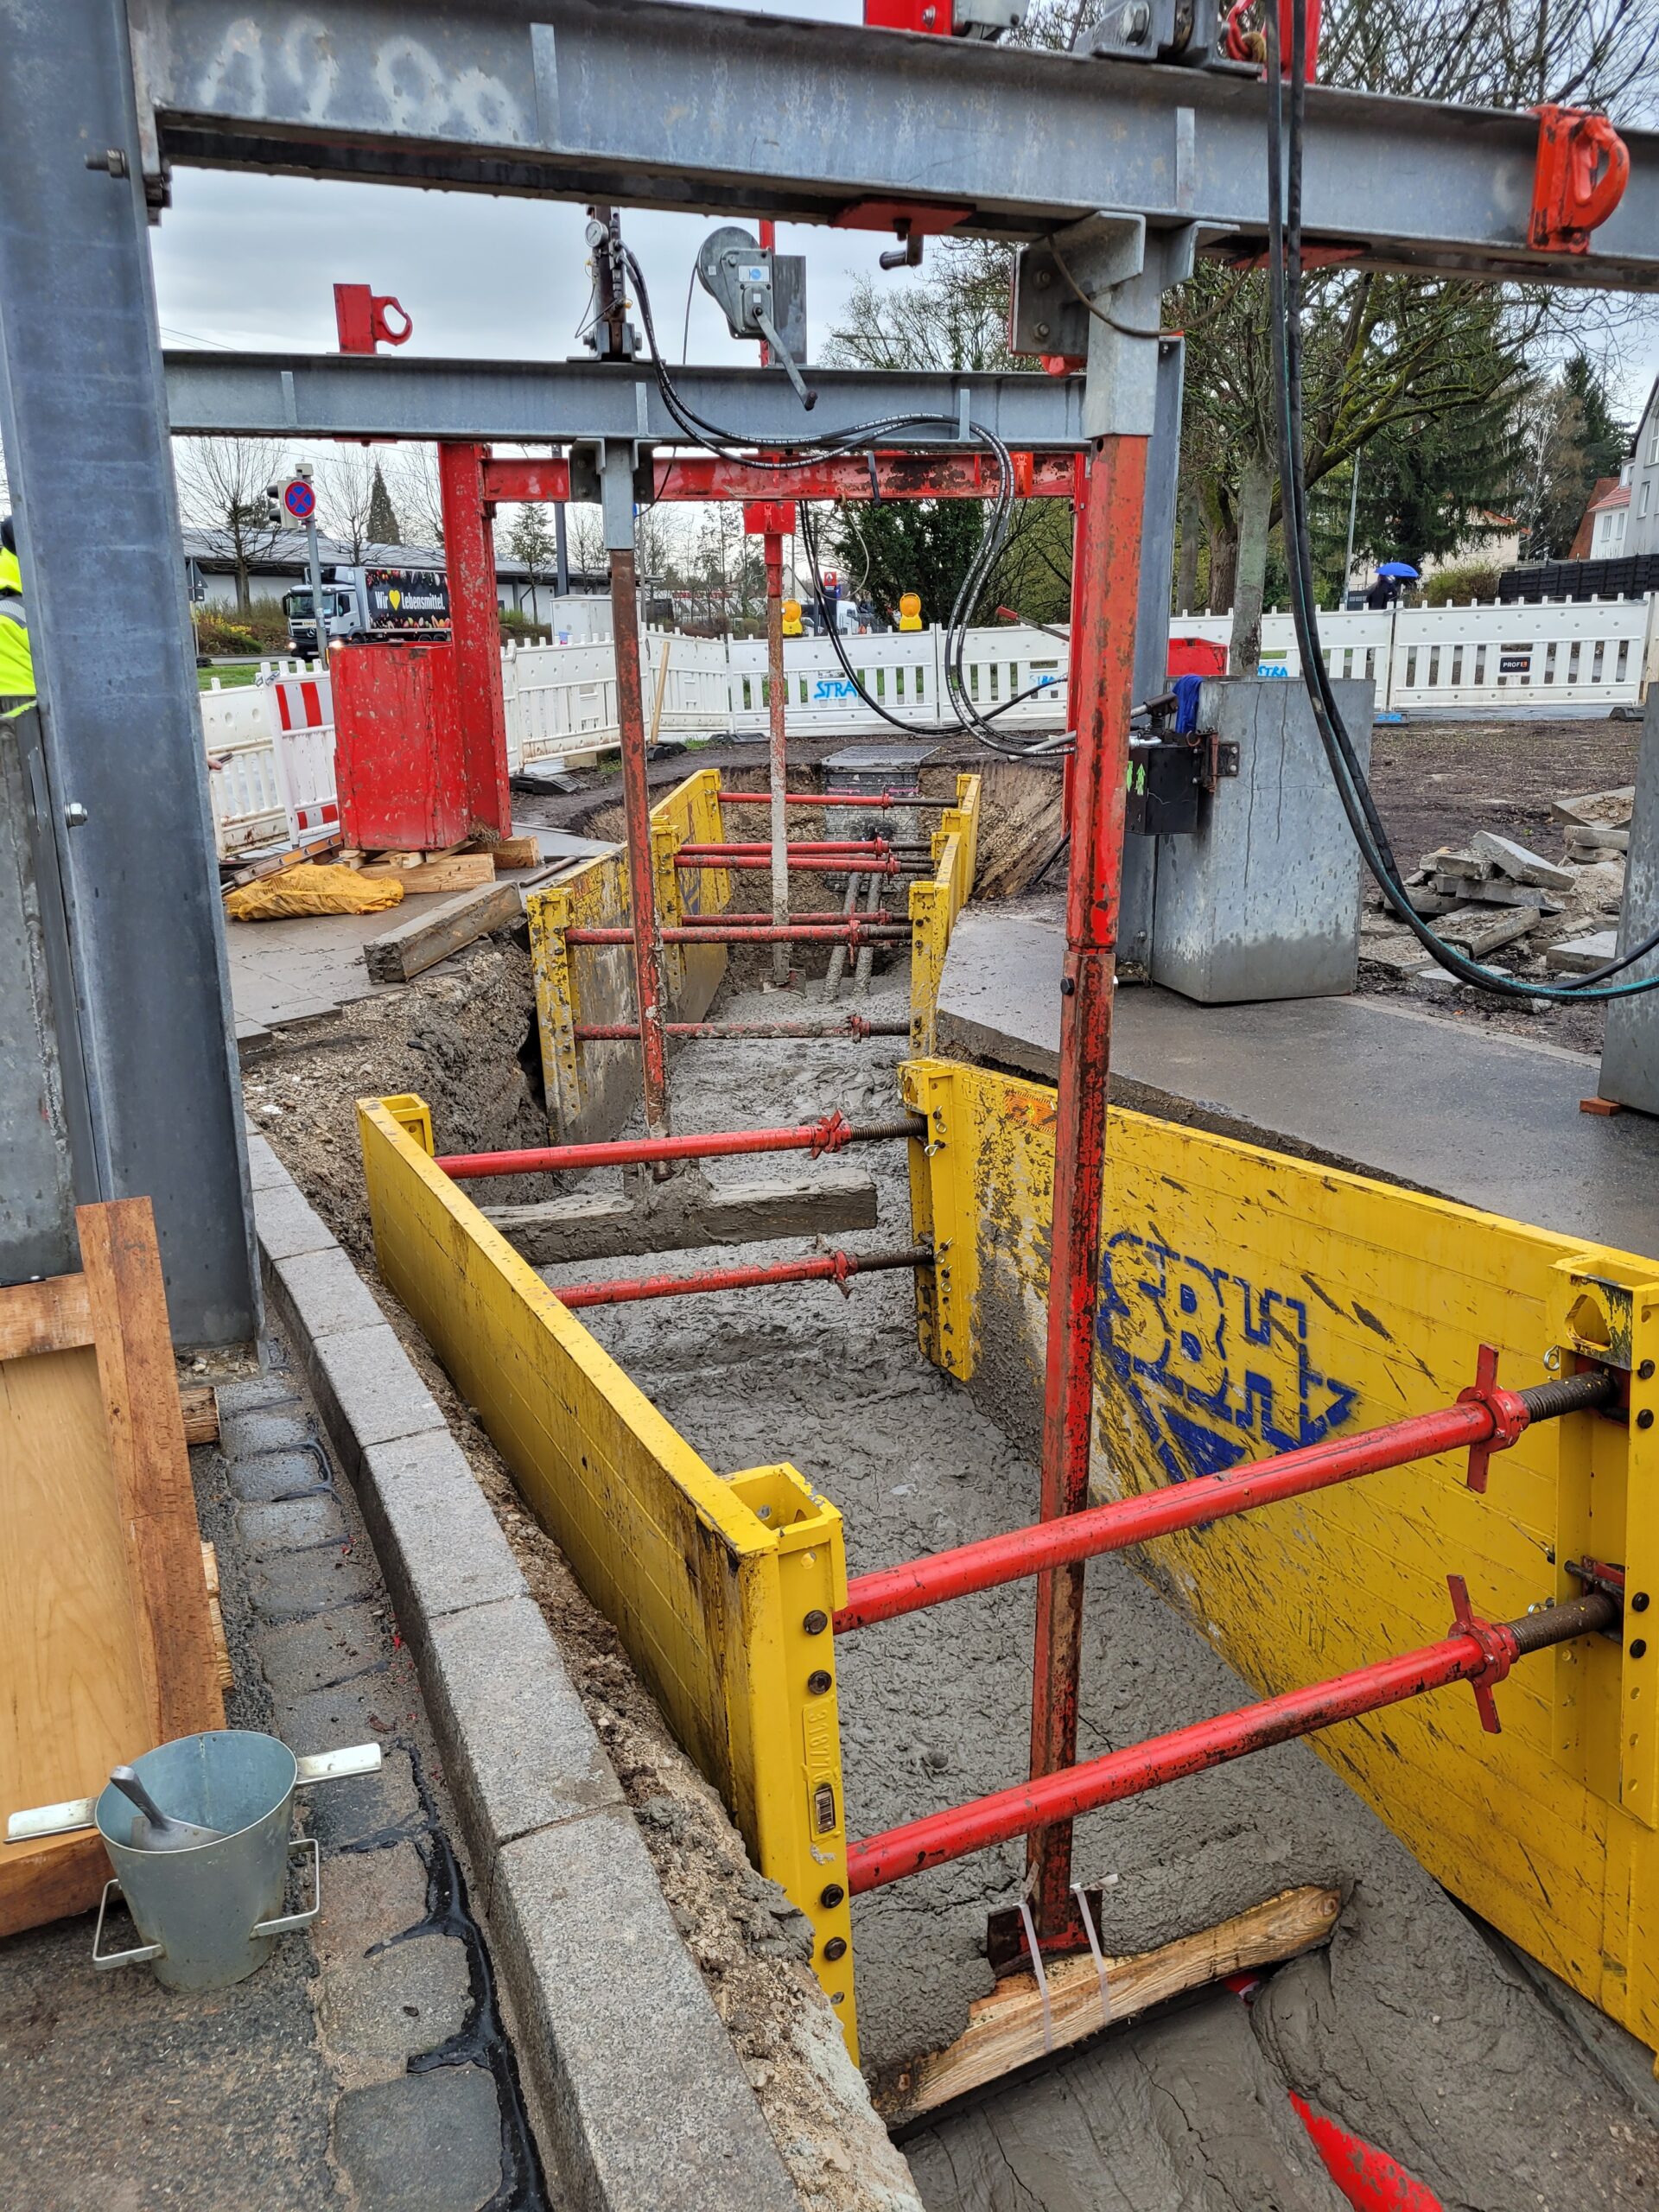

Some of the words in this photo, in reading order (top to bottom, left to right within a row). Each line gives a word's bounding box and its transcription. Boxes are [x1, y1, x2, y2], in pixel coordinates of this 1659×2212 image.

[375, 591, 388, 609] Wir
[401, 591, 446, 610] Lebensmittel.
[813, 680, 857, 699] STRA
[1097, 1230, 1308, 1452] SBH
